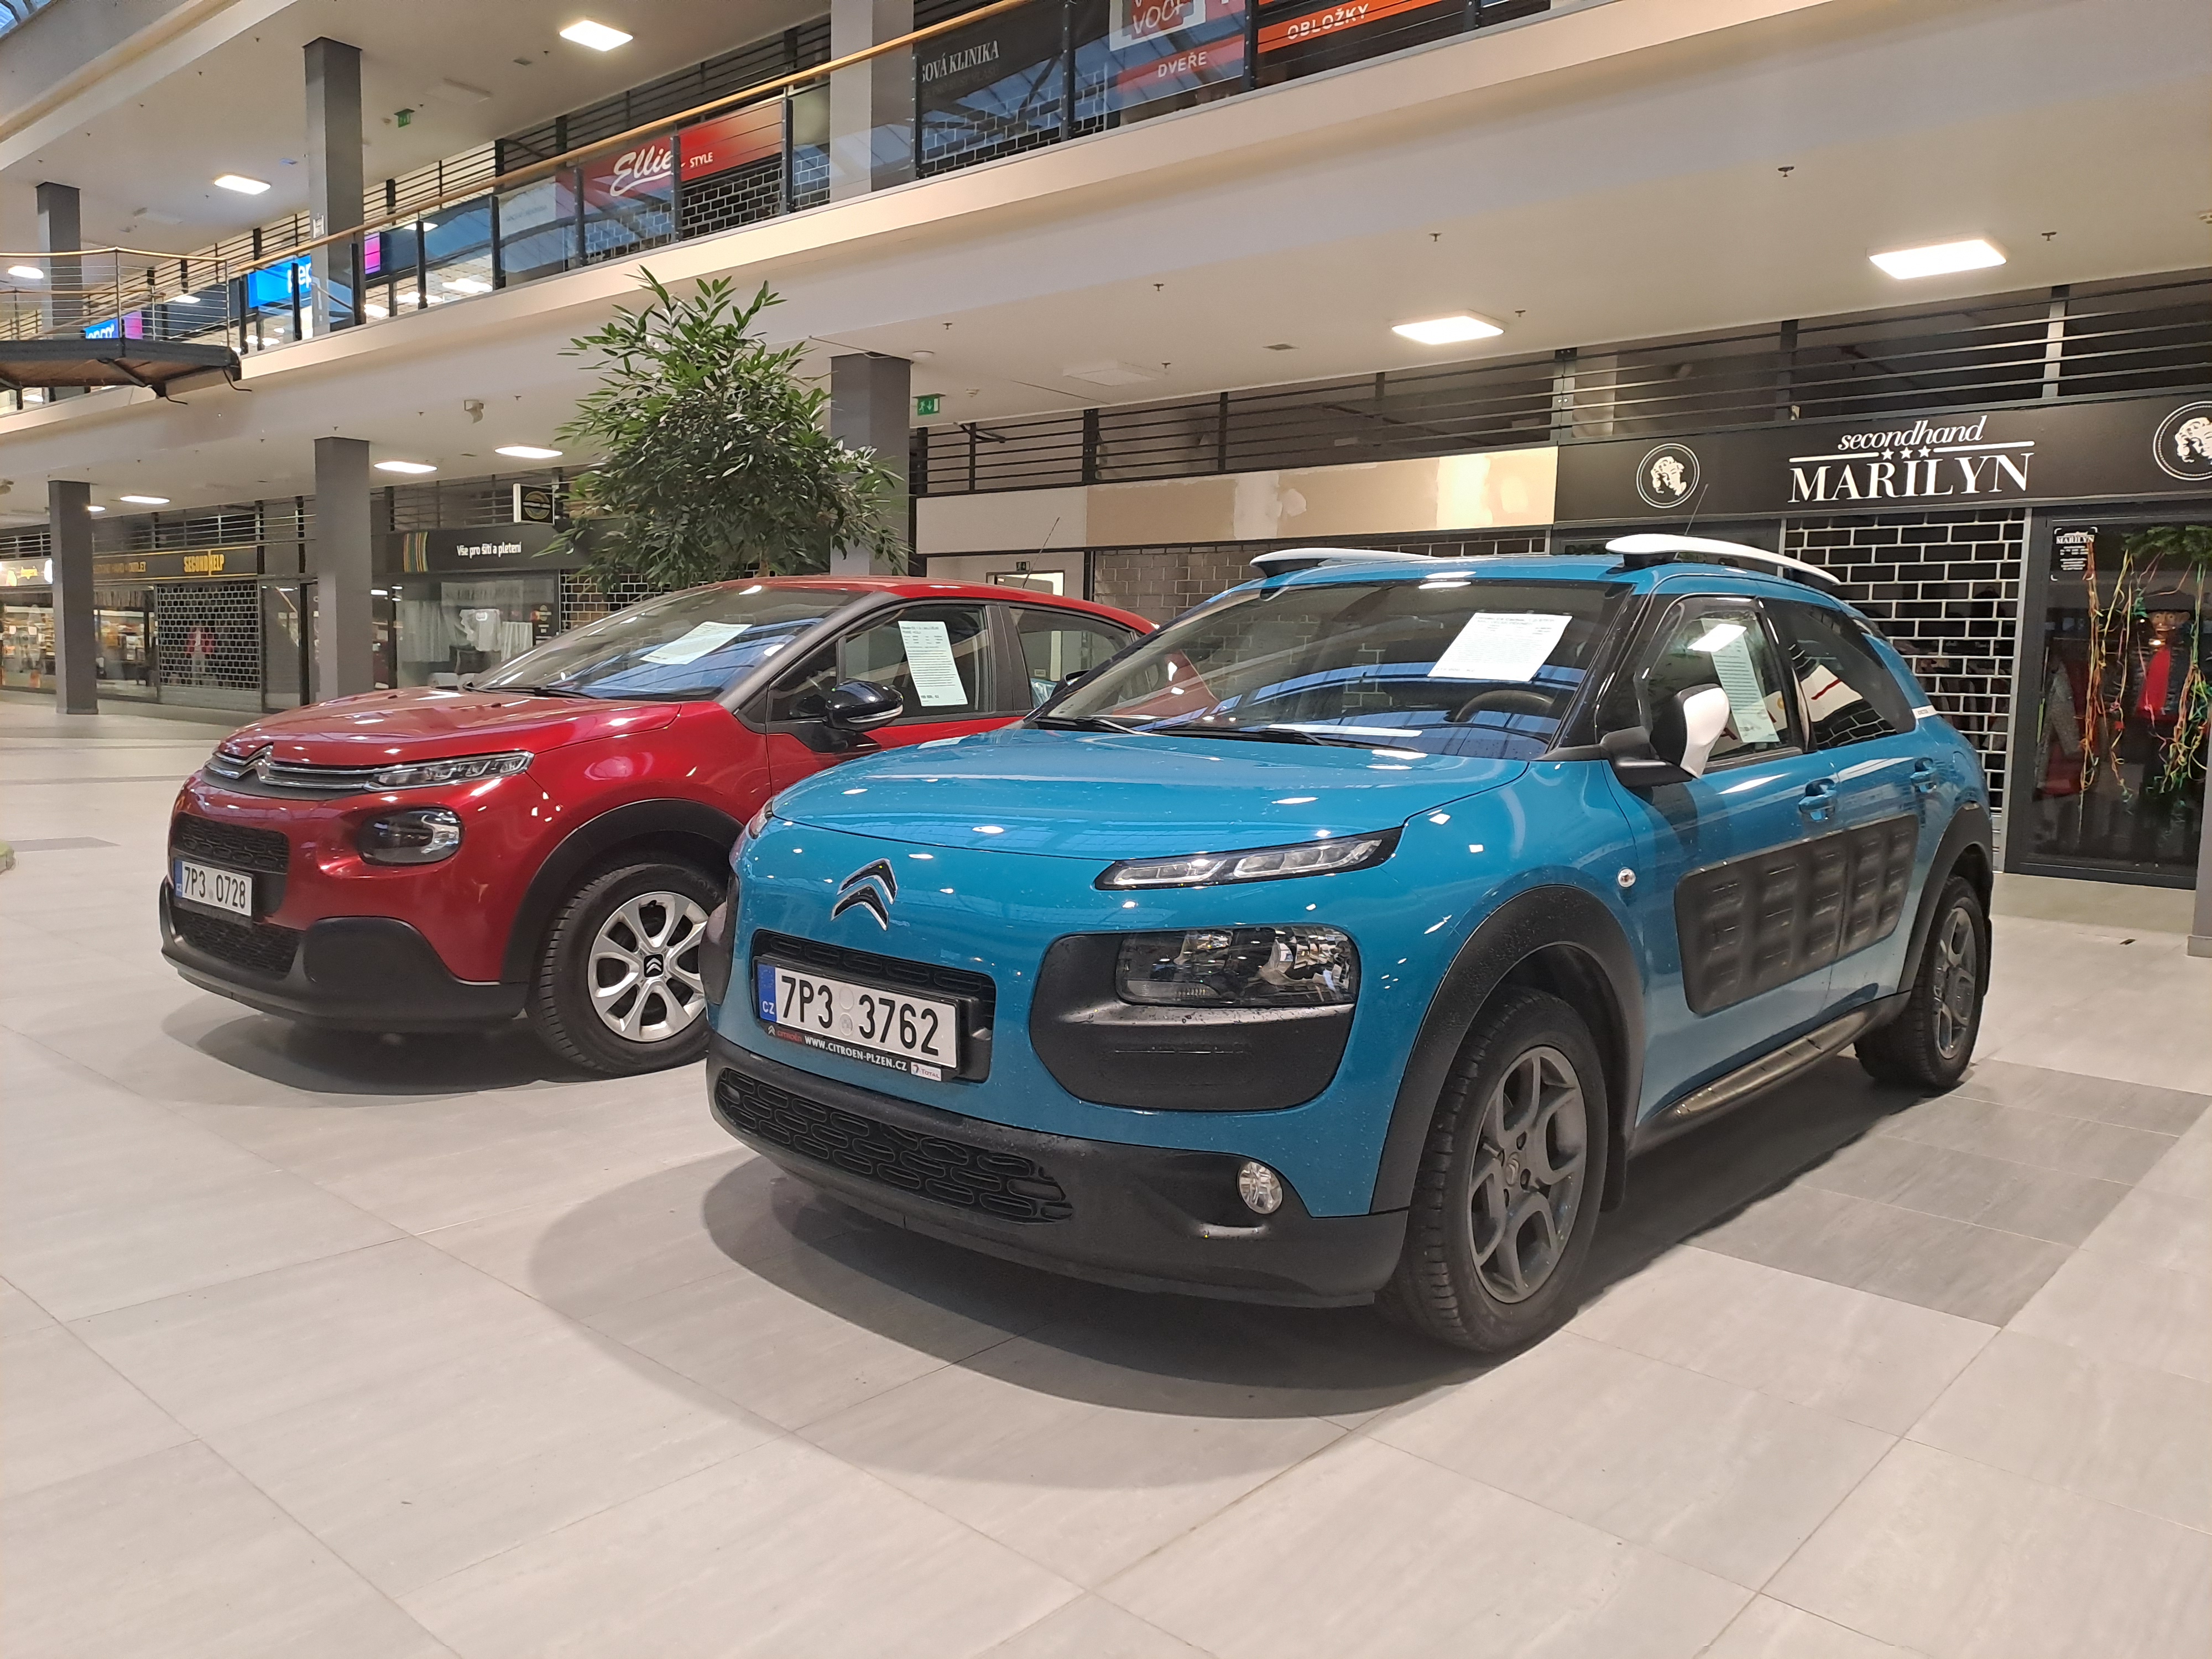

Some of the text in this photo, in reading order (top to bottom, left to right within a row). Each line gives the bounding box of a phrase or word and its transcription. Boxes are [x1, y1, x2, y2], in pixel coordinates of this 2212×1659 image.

[1287, 3, 1369, 40] OBLOŽKY
[949, 40, 999, 74] KLINIKA
[1158, 51, 1207, 77] DVEŘE
[690, 152, 713, 168] STYLE
[1837, 414, 1987, 451] secondhand
[1787, 452, 2035, 504] MARILYN
[456, 545, 468, 556] Vše
[469, 546, 481, 559] pro
[493, 546, 497, 554] a
[185, 866, 246, 909] 7P3 0728
[762, 999, 775, 1015] CZ
[781, 975, 940, 1057] 7P3 3762
[804, 1035, 907, 1072] WWW.CITROEN-PLZEN.CZ
[921, 1068, 940, 1079] TOTAL
